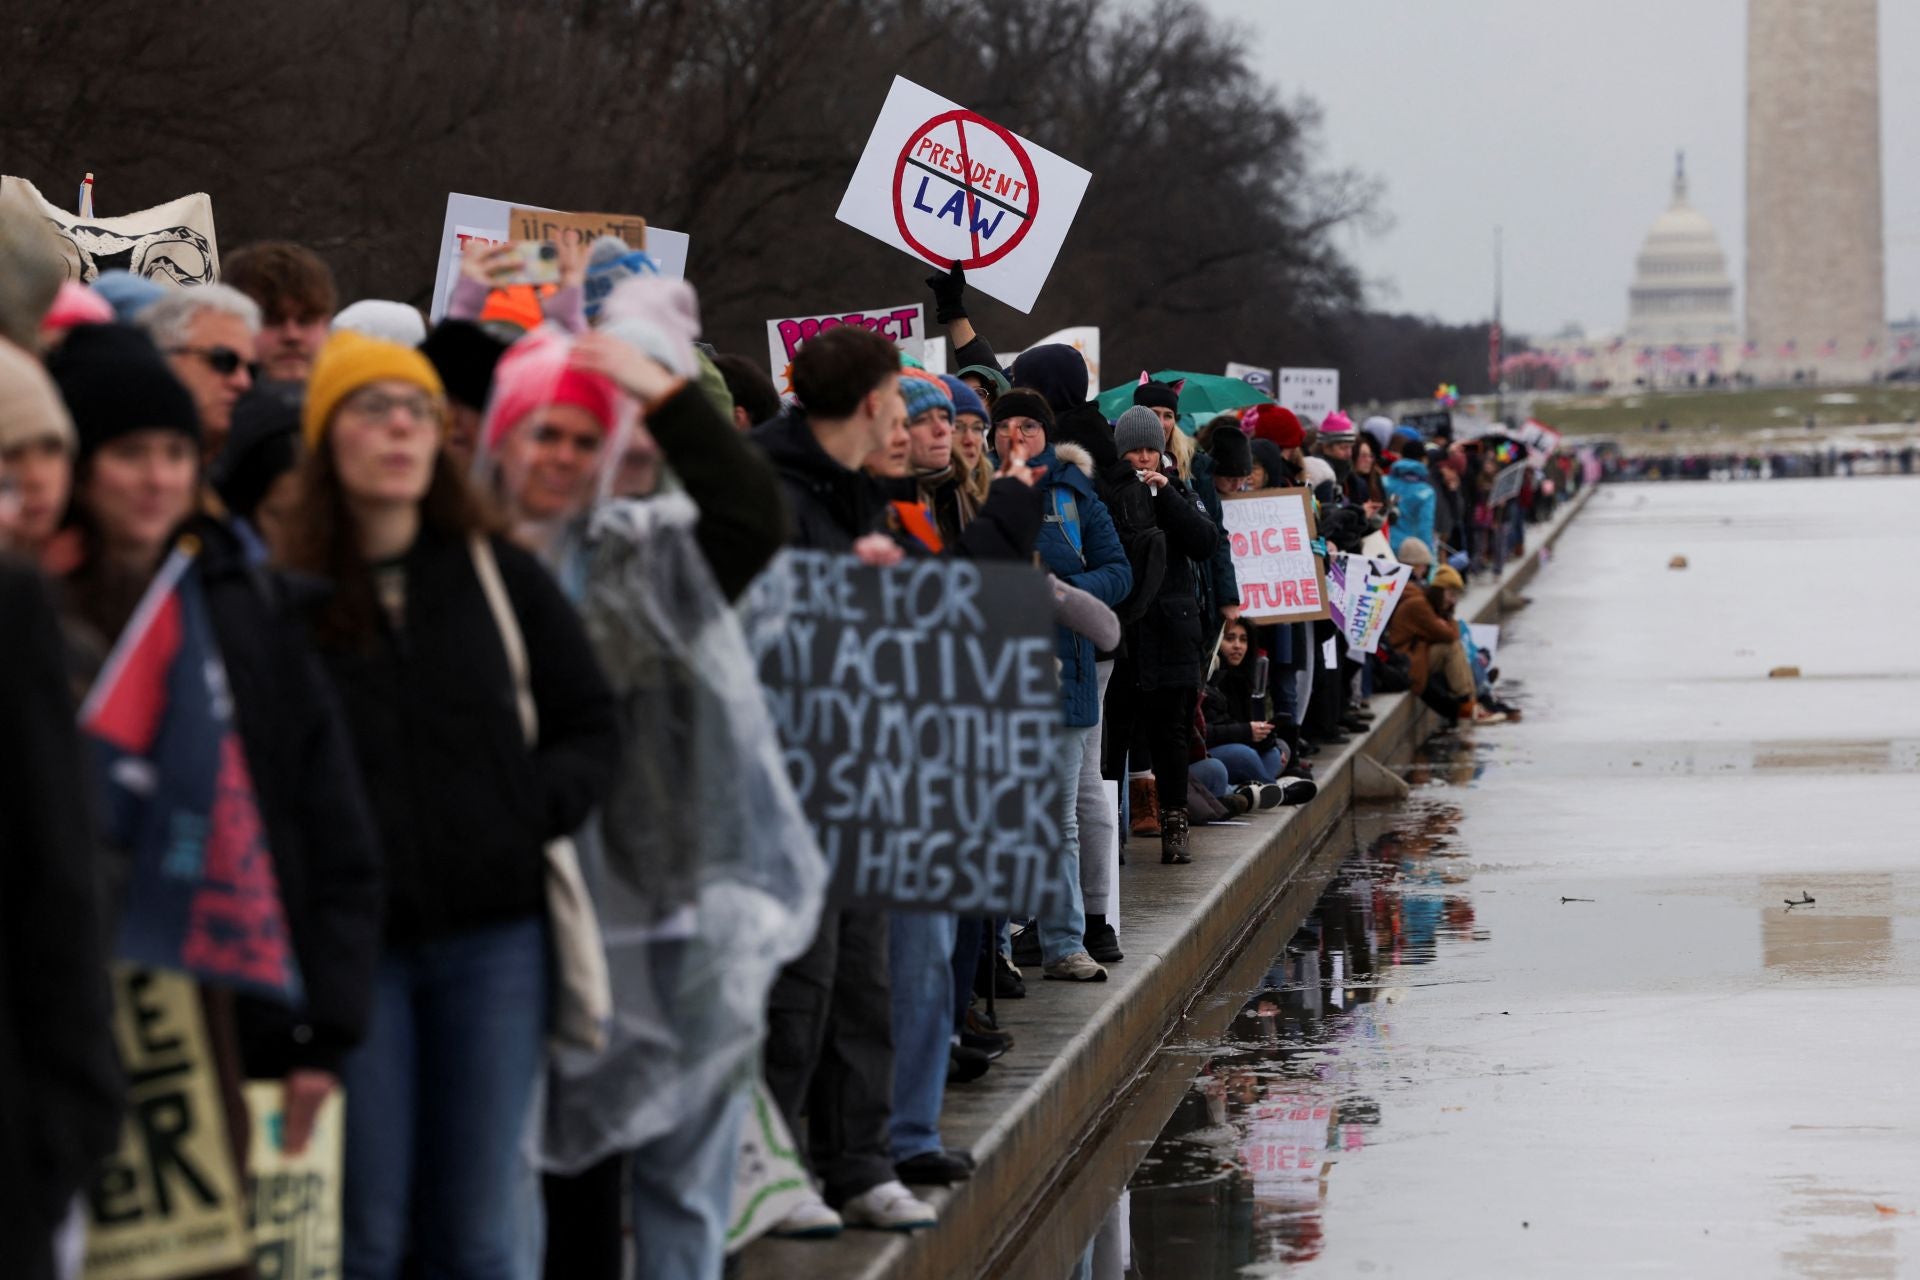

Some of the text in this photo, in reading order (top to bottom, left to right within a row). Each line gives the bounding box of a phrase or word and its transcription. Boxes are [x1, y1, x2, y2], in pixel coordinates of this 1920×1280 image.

[917, 138, 1026, 201] PRESIDENT
[913, 176, 1005, 240] LAW
[1224, 500, 1282, 528] OUR
[1229, 528, 1301, 557] OICE
[878, 557, 986, 634] FOR
[1239, 578, 1319, 611] UTURE
[832, 625, 1056, 706] ACTIVE
[766, 684, 872, 752] UTY
[823, 749, 914, 828] SAY
[914, 762, 1062, 852] FUCK
[855, 822, 1066, 917] HEGSETH
